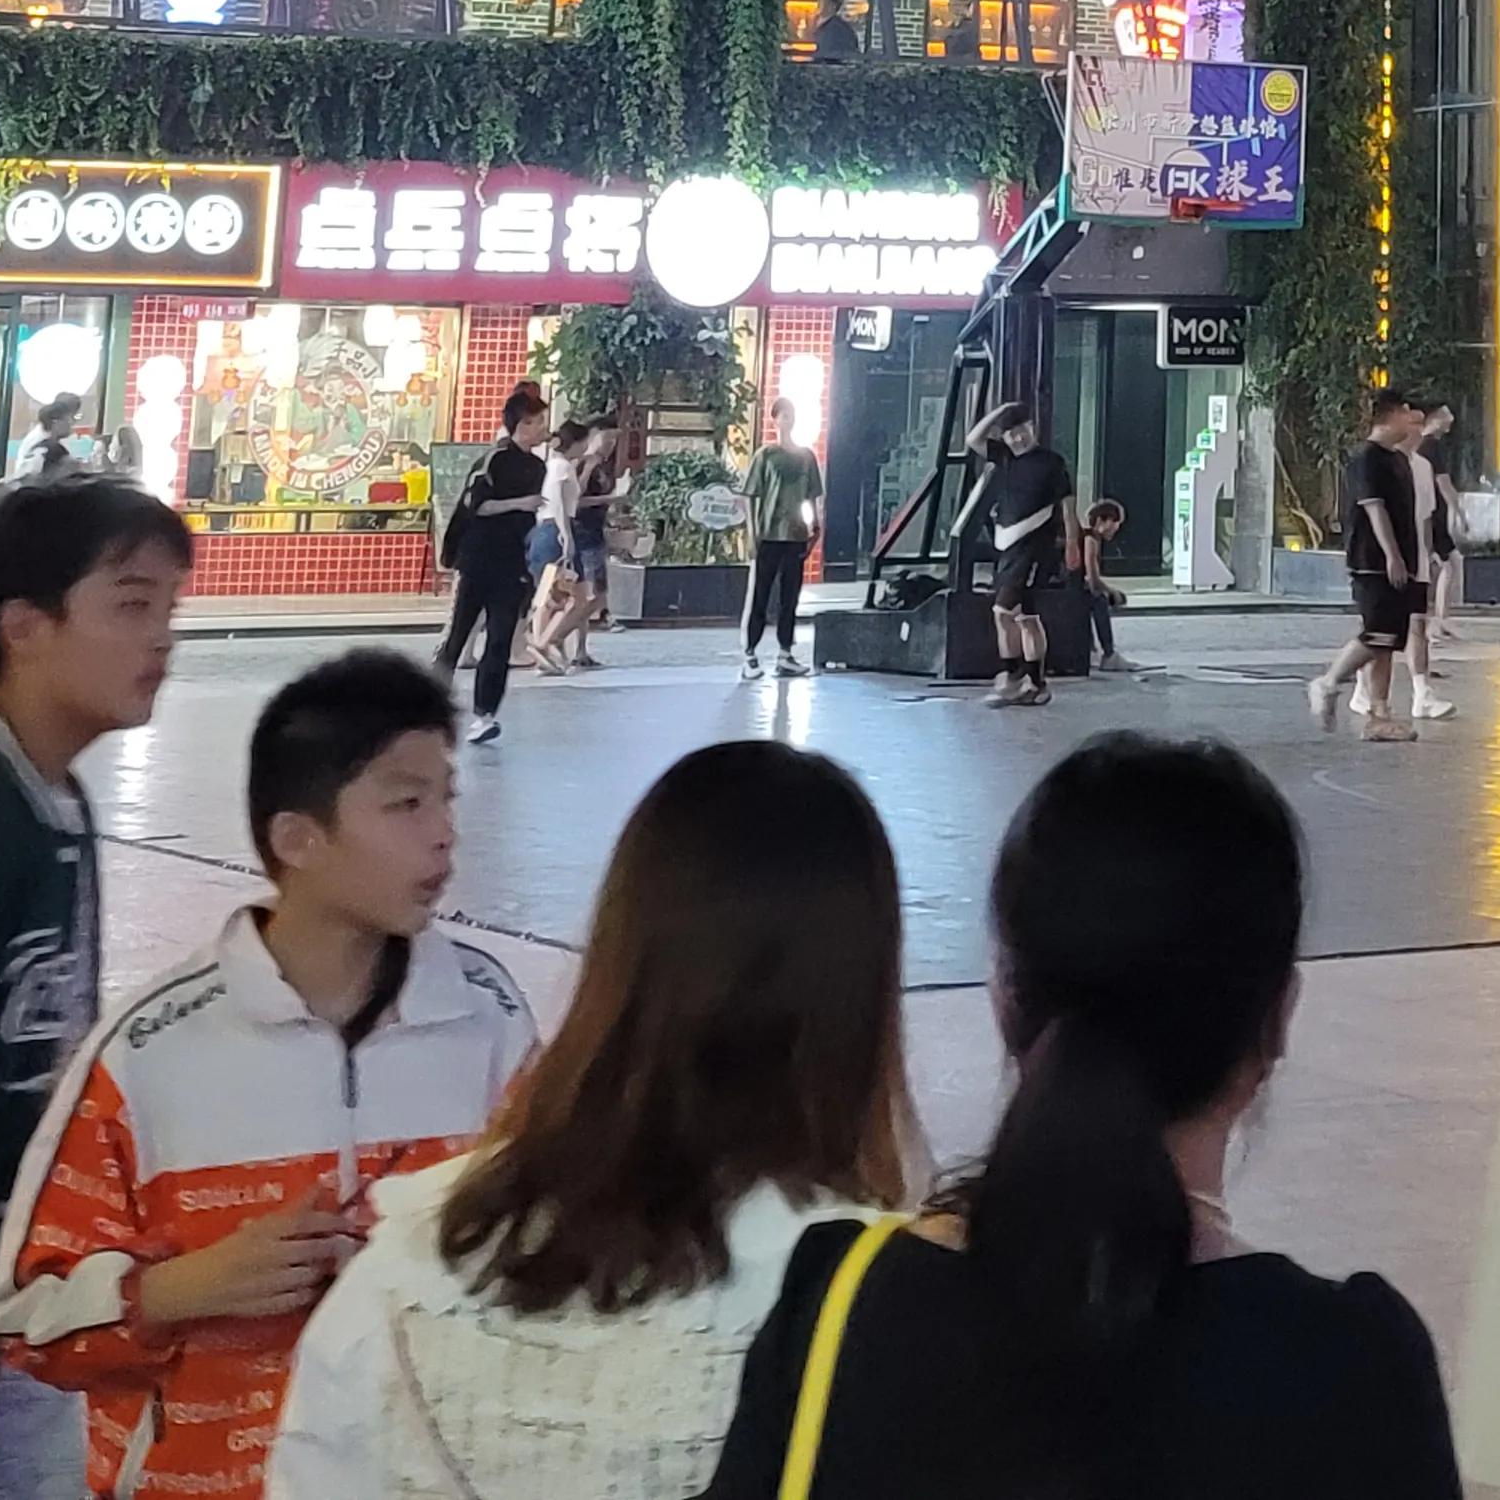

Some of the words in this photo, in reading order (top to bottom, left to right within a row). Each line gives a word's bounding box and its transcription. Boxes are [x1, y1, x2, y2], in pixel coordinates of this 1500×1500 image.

[1167, 167, 1211, 198] PK
[1216, 159, 1294, 203] 球王
[296, 187, 643, 274] 点兵点将
